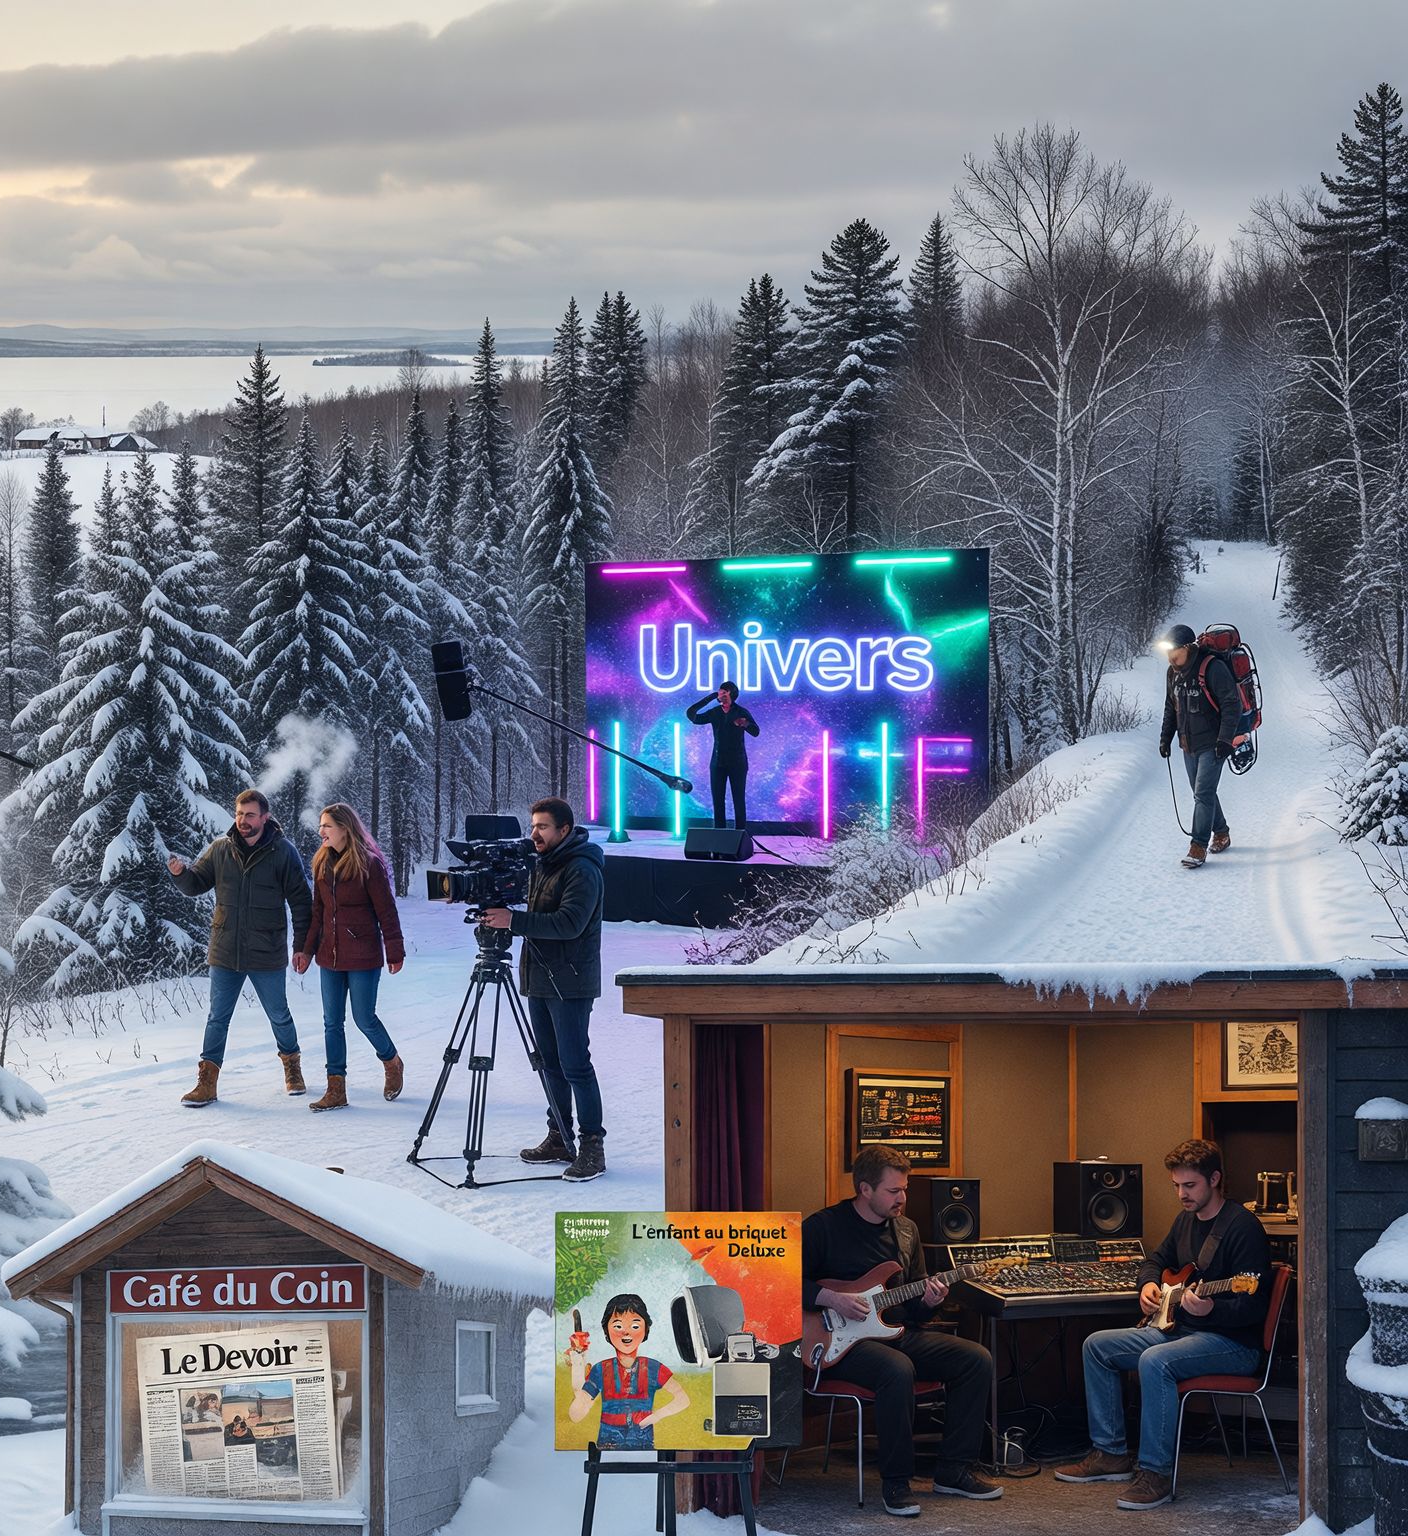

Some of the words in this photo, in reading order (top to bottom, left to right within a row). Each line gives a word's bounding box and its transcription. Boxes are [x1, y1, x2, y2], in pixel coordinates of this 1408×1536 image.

[639, 621, 934, 693] Univers
[704, 1228, 724, 1239] au
[728, 1224, 787, 1244] briquet
[728, 1243, 785, 1257] Deluxe
[123, 1275, 202, 1307] Café
[213, 1274, 257, 1306] du
[271, 1271, 353, 1305] Coin
[161, 1347, 198, 1376] Le
[200, 1338, 298, 1372] Devoir
